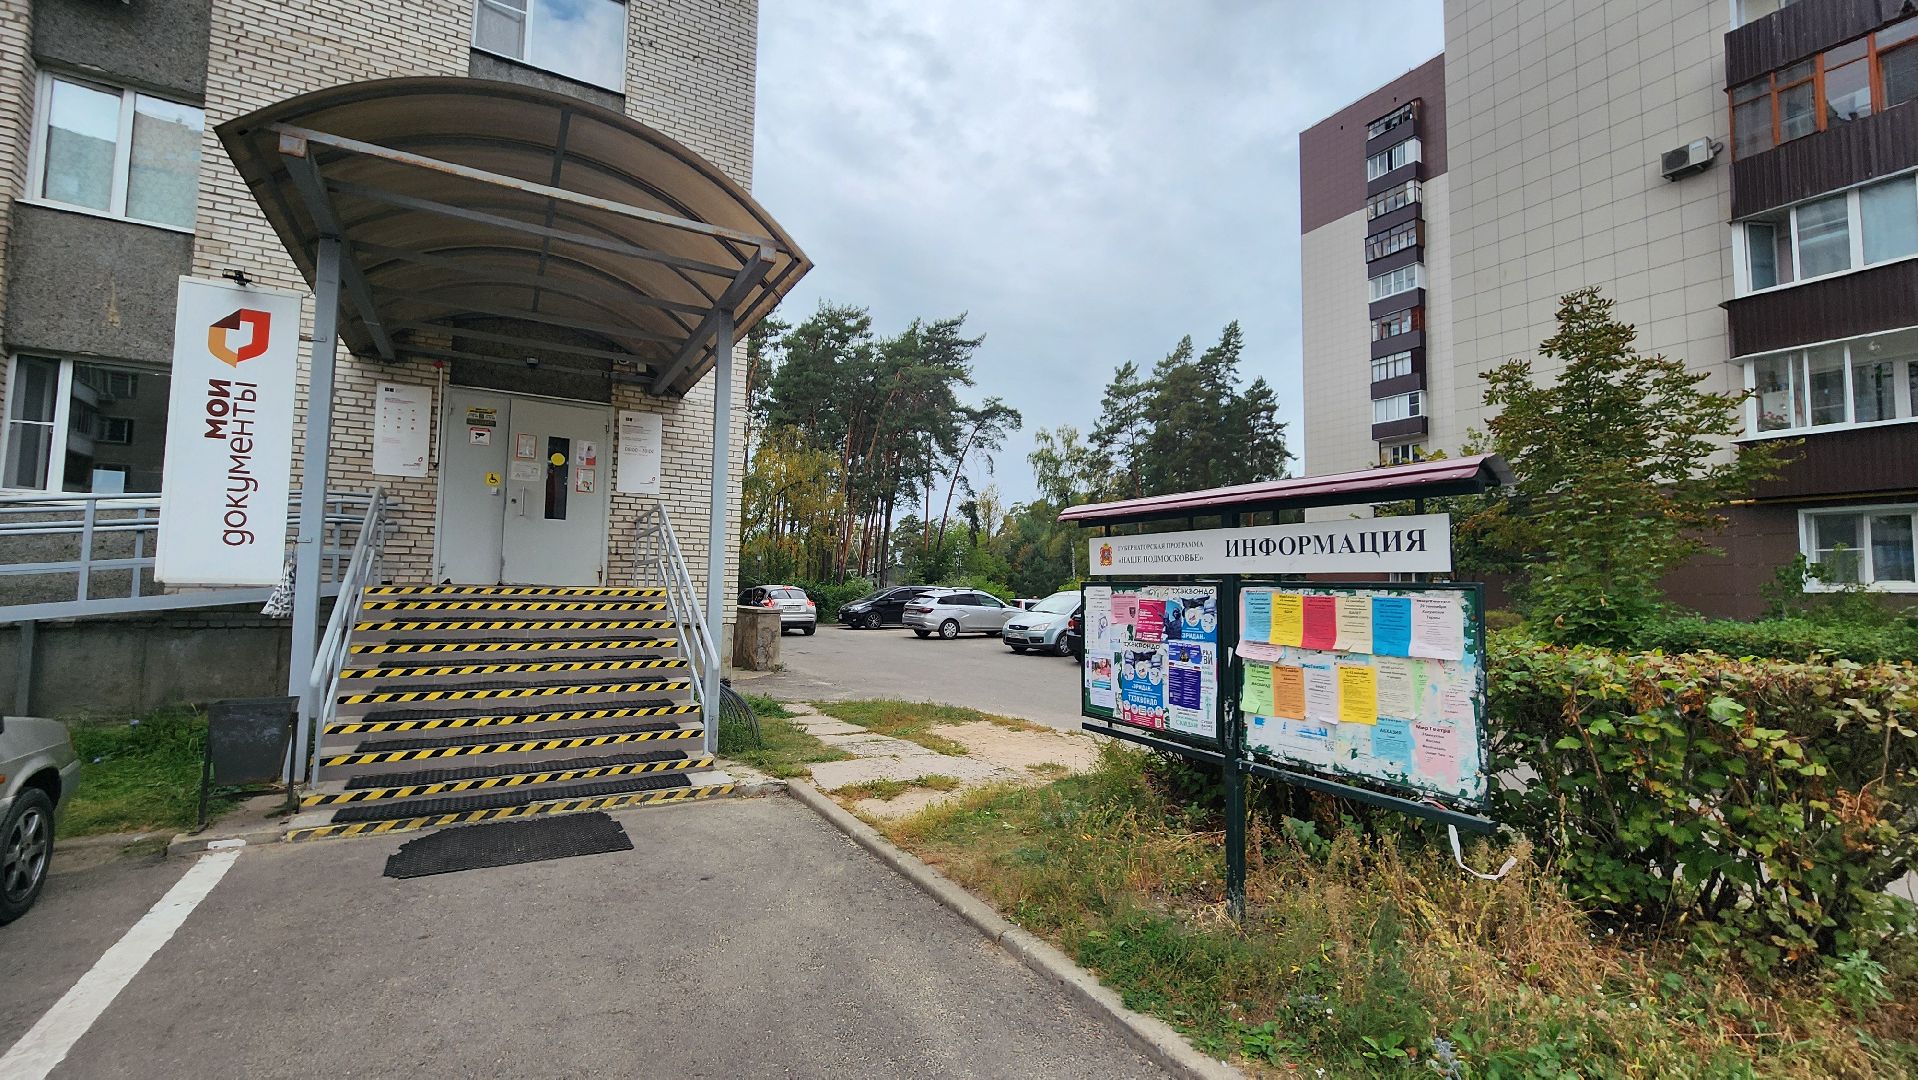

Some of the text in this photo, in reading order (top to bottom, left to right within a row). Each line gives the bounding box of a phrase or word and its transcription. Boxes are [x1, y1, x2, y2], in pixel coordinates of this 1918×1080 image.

[222, 381, 259, 546] документы
[1117, 540, 1204, 552] ГУБЕРНАТОРСКАЯ ПРОГРАММА
[1225, 528, 1428, 558] ИНФОРМАЦИЯ
